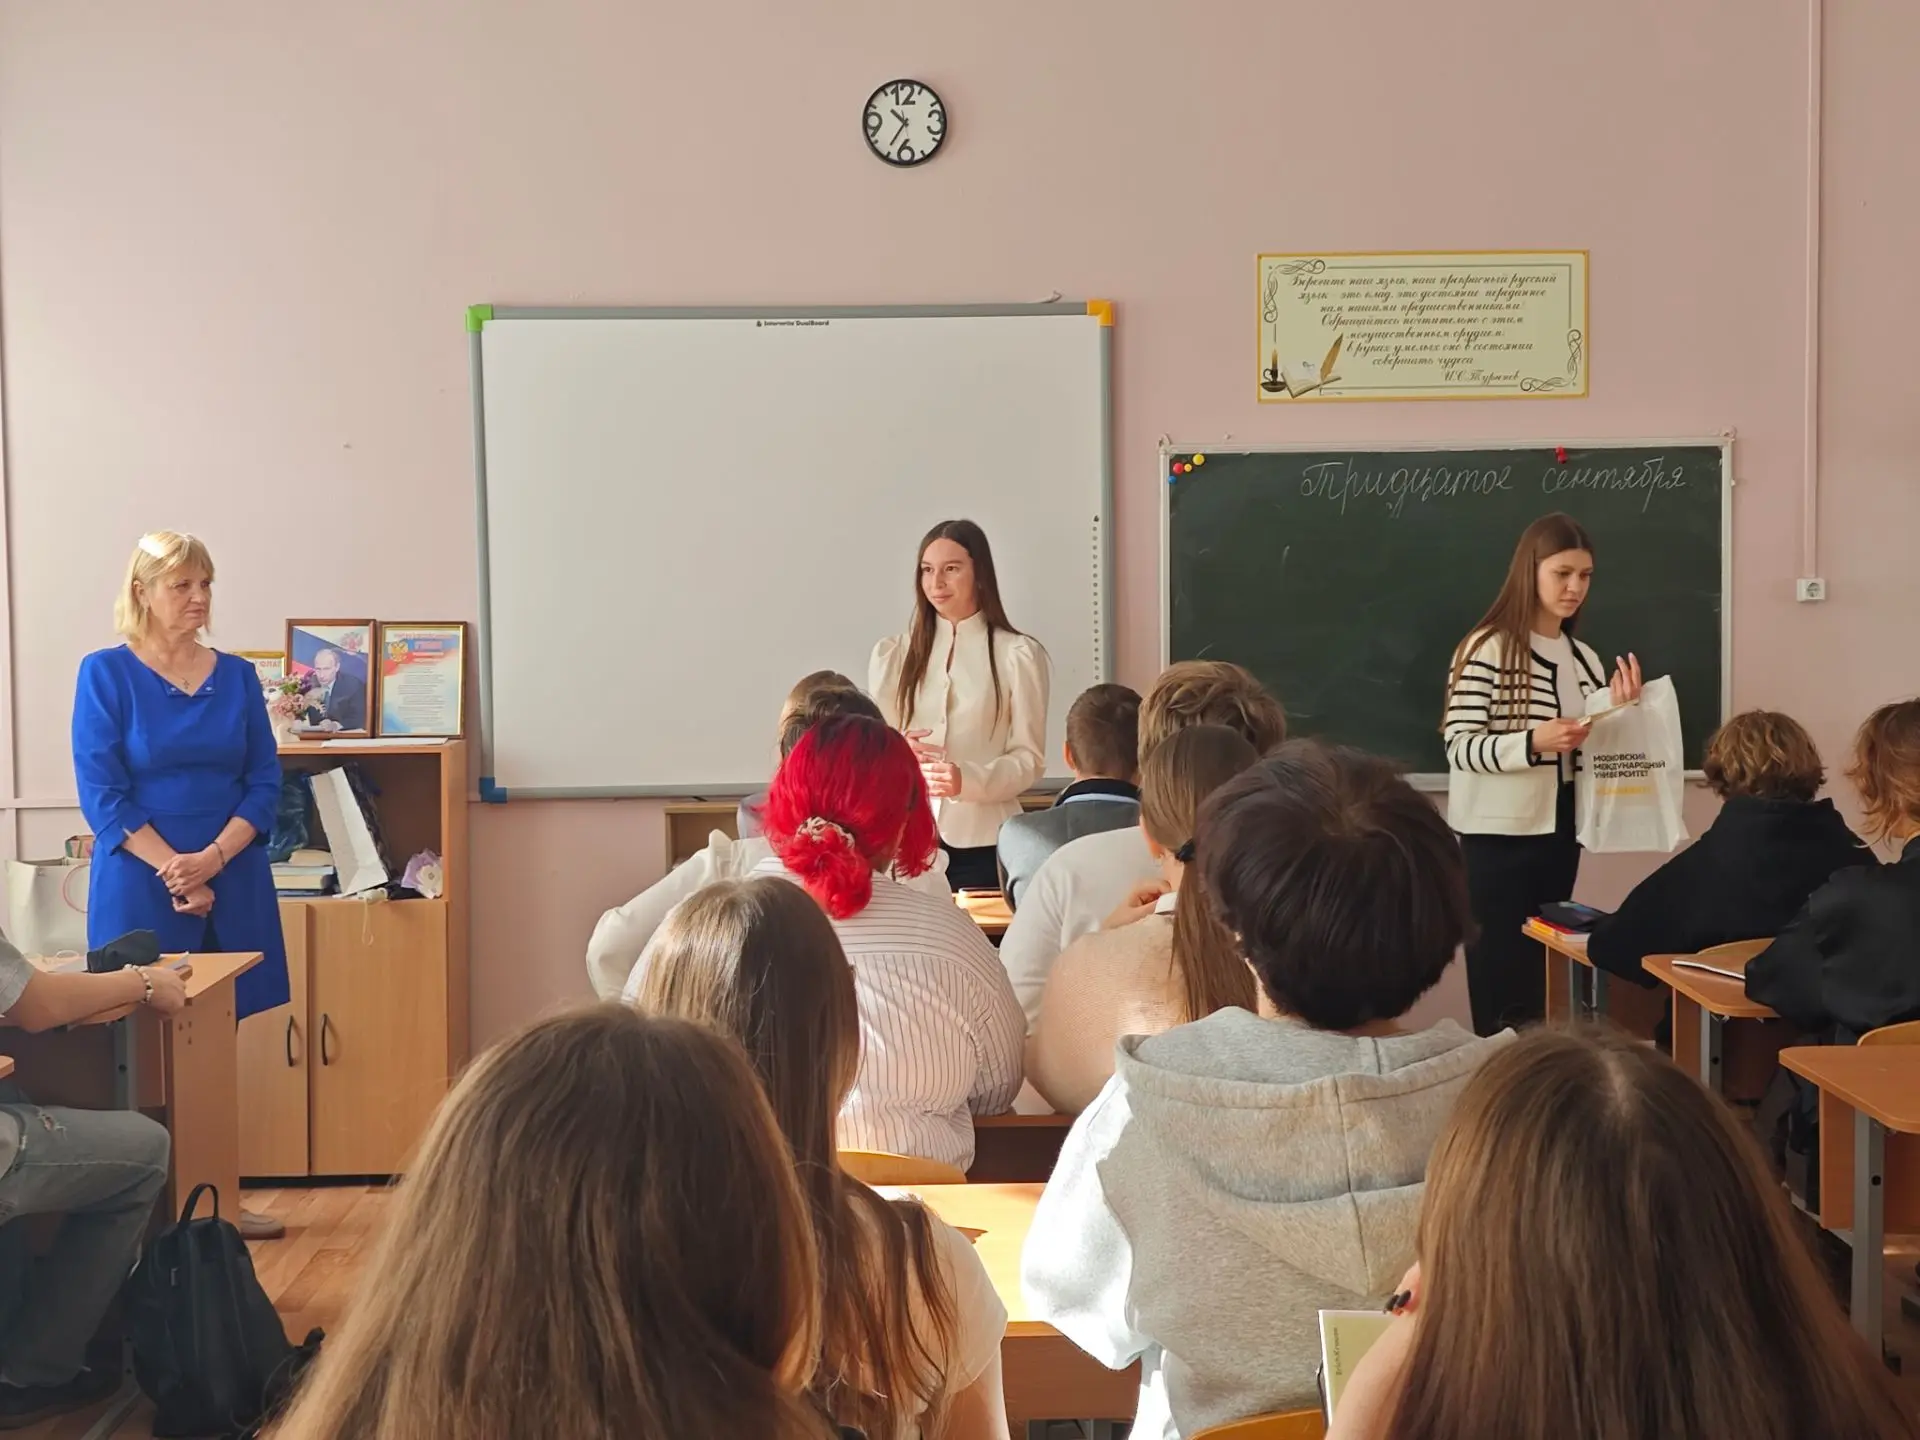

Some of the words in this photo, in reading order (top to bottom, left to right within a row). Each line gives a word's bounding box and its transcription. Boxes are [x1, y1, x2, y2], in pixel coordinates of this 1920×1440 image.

[890, 83, 916, 106] 12
[867, 111, 883, 137] 9
[926, 109, 944, 135] 3
[897, 138, 915, 162] 6
[1292, 274, 1345, 291] Берегите
[1349, 277, 1373, 285] наш
[1412, 277, 1436, 285] наш
[1440, 274, 1508, 289] прекрасный
[1508, 273, 1556, 288] русский
[1298, 292, 1328, 304] язык
[1320, 305, 1343, 313] нам
[1347, 304, 1397, 312] нашими
[1321, 313, 1400, 332] Обращайтесь
[1402, 316, 1479, 326] почтительно
[1492, 316, 1524, 325] этим
[1353, 342, 1390, 357] руках
[1392, 343, 1441, 357] умелых
[1473, 343, 1533, 352] состоянии
[1372, 354, 1434, 371] совершать
[1301, 457, 1512, 517] Тридцатое
[1542, 456, 1688, 513] сентября
[1593, 752, 1646, 762] МОСКОВСКИЙ
[1593, 760, 1666, 771] МЕЖДУНАРОДНЫЙ
[1594, 770, 1649, 779] УНИВЕРСИТЕТ
